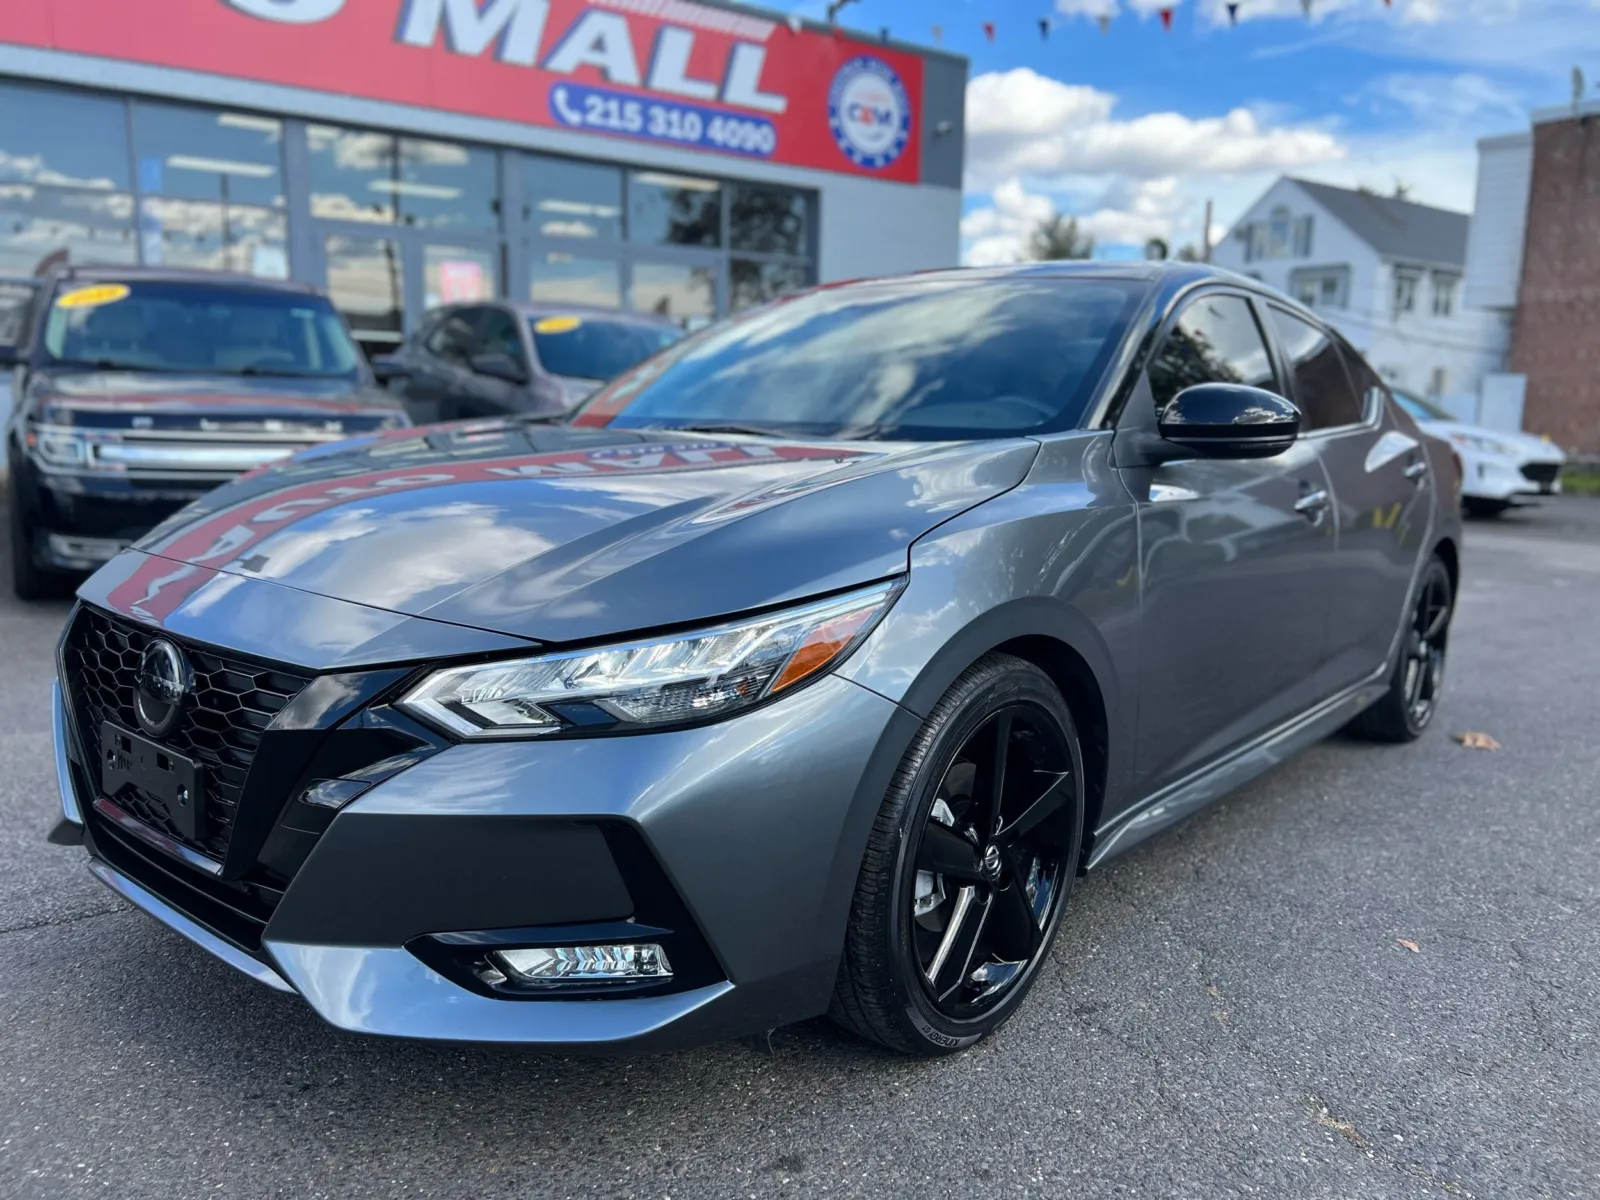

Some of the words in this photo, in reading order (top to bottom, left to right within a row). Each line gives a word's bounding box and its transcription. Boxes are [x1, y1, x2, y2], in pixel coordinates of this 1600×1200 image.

[395, 0, 788, 114] MALL
[583, 94, 643, 133] 215
[647, 105, 703, 143] 310
[706, 115, 777, 155] 4090
[921, 1025, 932, 1034] GT
